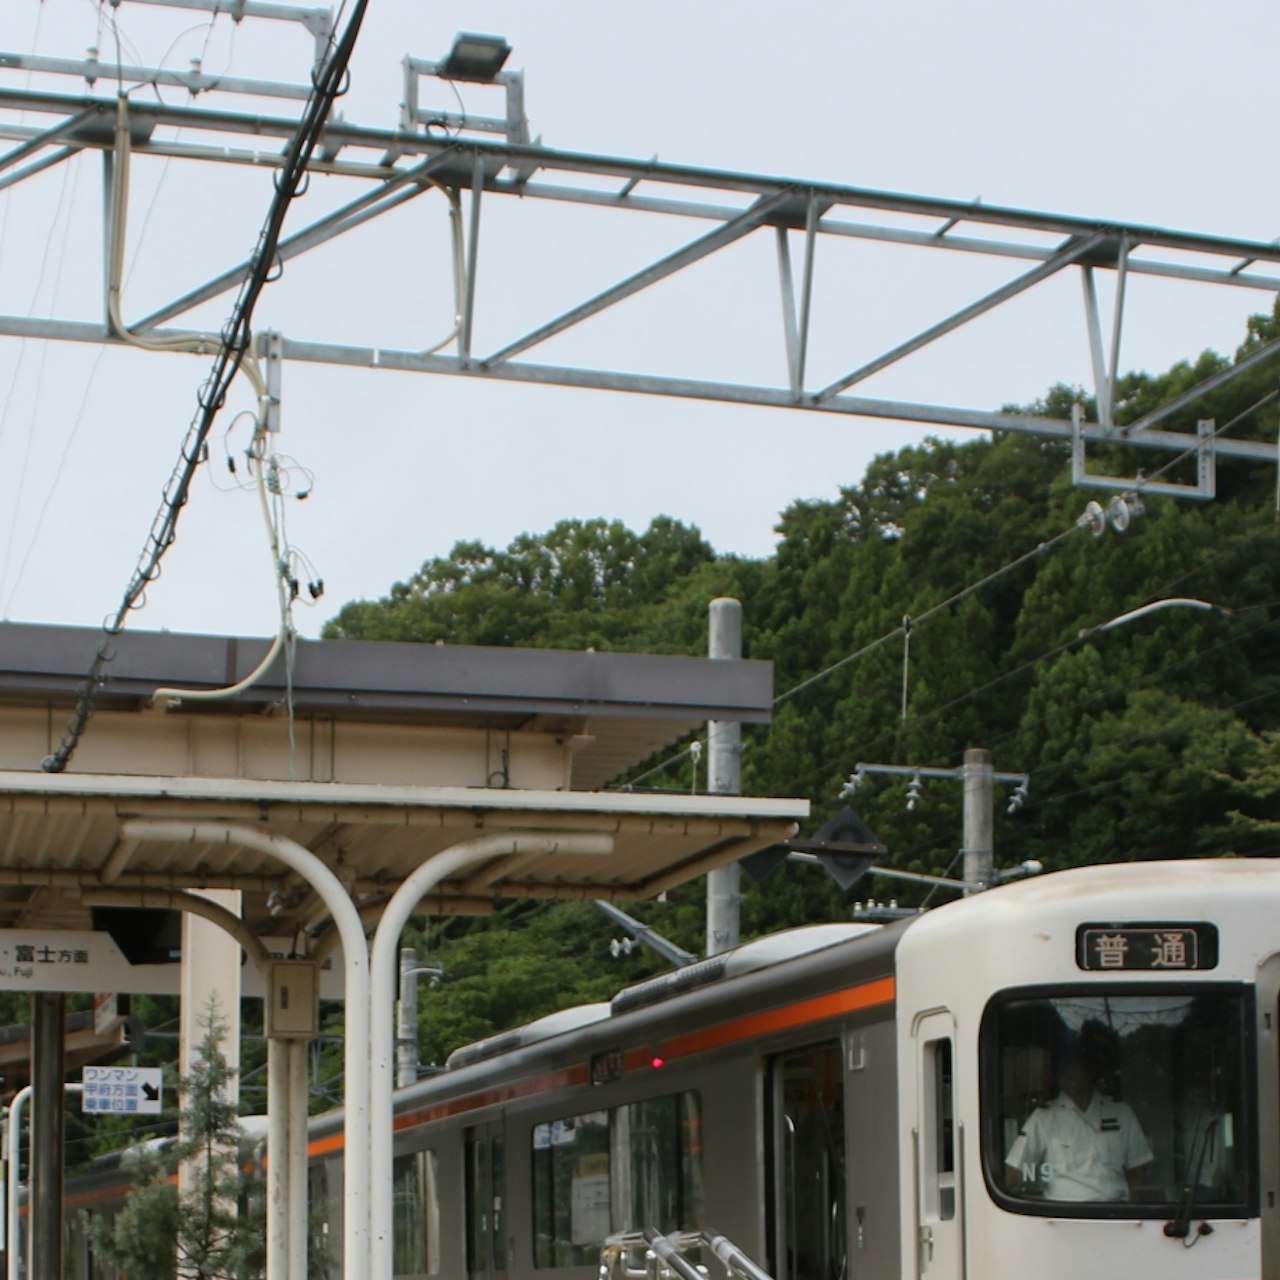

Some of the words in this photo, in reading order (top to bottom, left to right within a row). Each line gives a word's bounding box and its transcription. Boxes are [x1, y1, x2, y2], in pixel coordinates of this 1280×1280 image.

[1095, 932, 1186, 967] 普通
[14, 966, 33, 979] Fuji
[85, 1069, 138, 1081] ワンマン
[85, 1083, 138, 1096] 甲府方面
